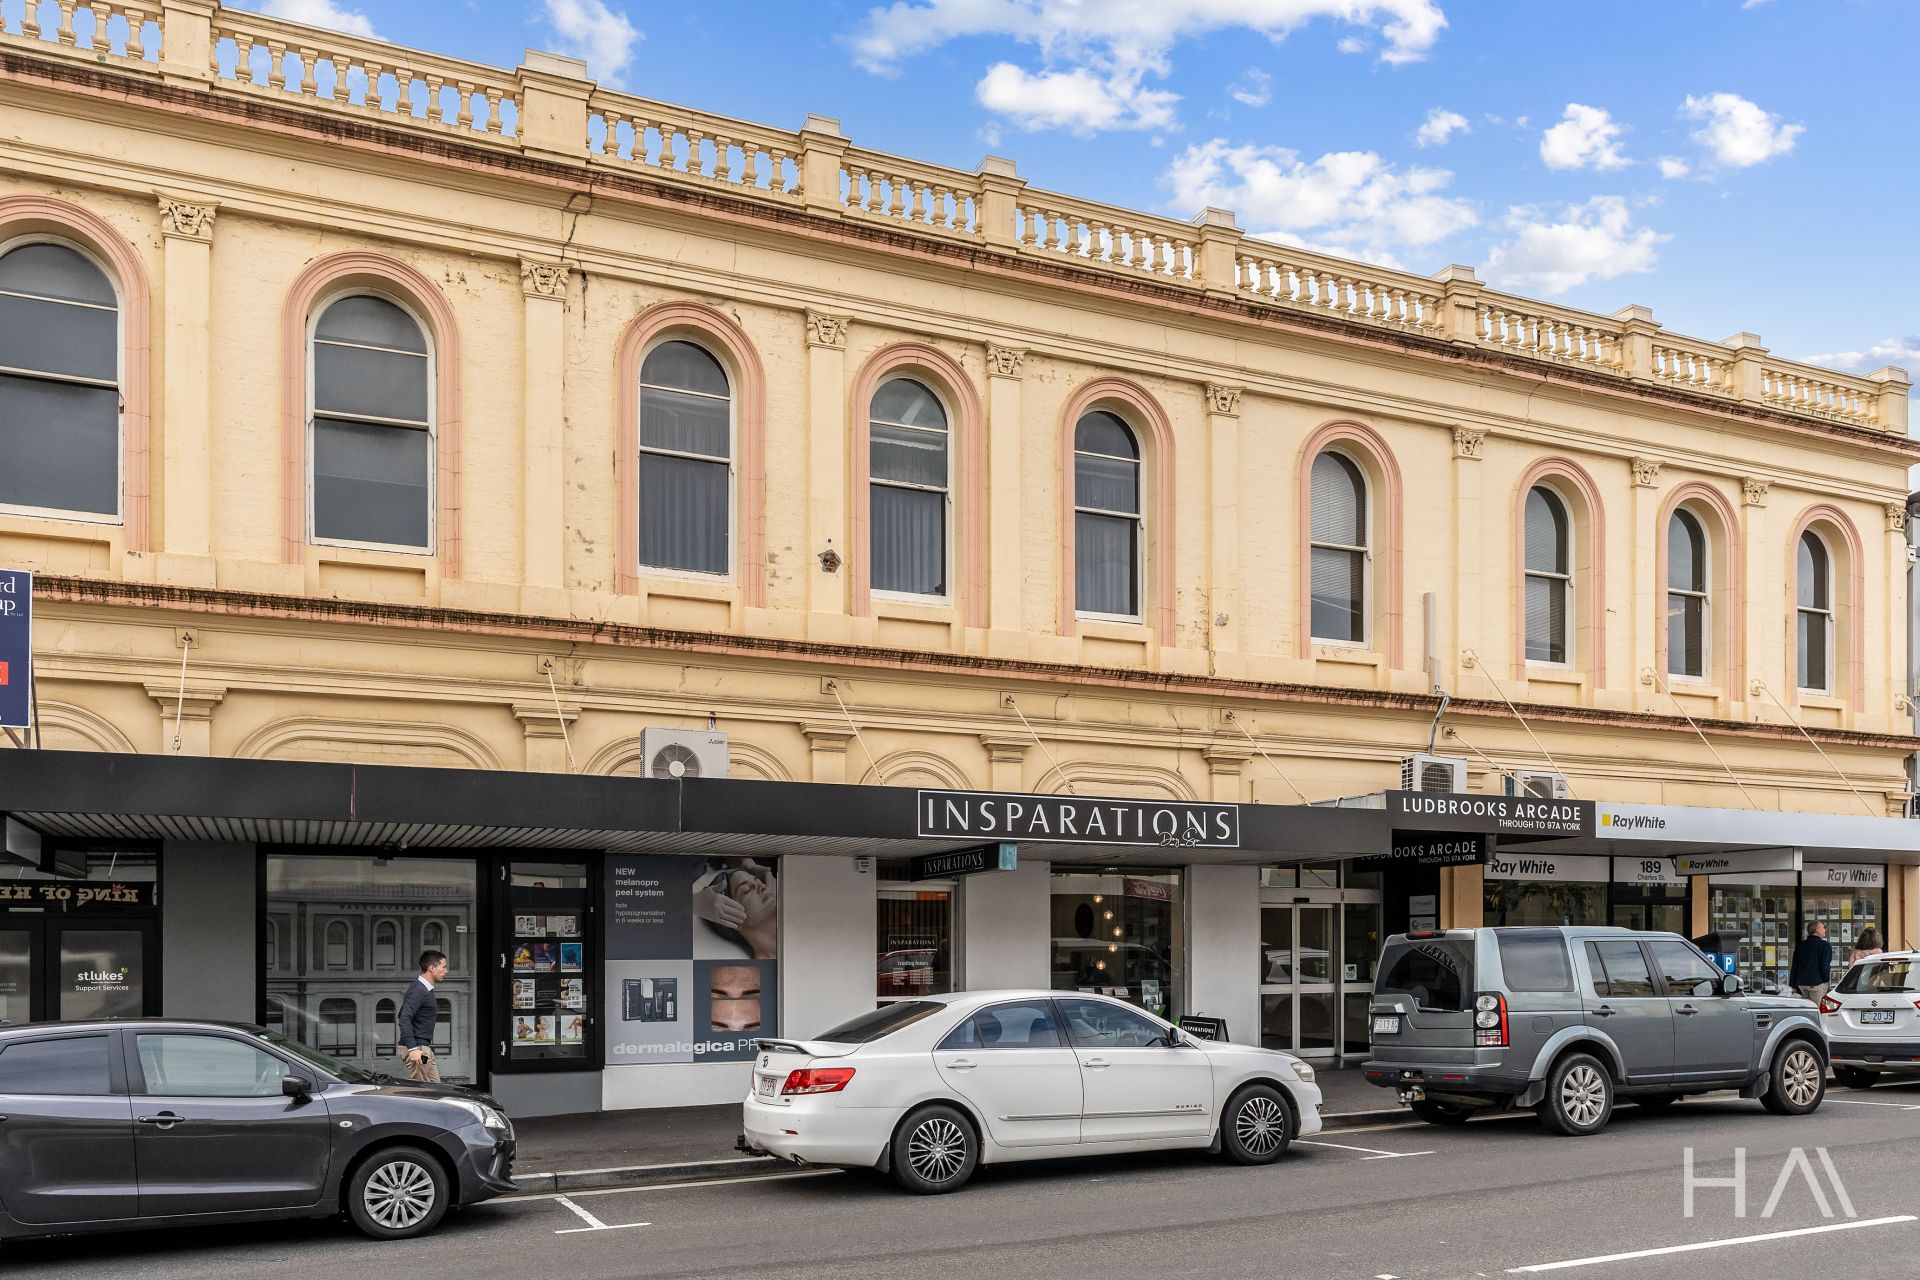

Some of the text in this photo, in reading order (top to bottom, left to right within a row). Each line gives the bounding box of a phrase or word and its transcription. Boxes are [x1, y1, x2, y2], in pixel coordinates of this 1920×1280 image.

[1403, 797, 1581, 820] LUDBROOKS ARCADE
[927, 798, 1230, 839] INSPARATIONS
[1499, 819, 1581, 830] THROUGH TO 97A YORK
[1159, 832, 1181, 848] Day
[1430, 841, 1477, 856] ARCADE
[924, 852, 983, 874] INSPARATIONS
[1491, 858, 1555, 876] Ray White
[1640, 861, 1661, 873] 189
[615, 868, 636, 876] NEW
[1637, 873, 1657, 881] Charles
[1827, 868, 1879, 882] Ray White
[615, 879, 659, 887] melanopro
[615, 889, 664, 897] peel system
[1725, 956, 1732, 970] P
[77, 970, 124, 981] st.lukes
[75, 984, 101, 992] Support
[1873, 1012, 1882, 1021] 20
[1883, 1012, 1893, 1021] JS
[612, 1040, 735, 1055] dermalogica
